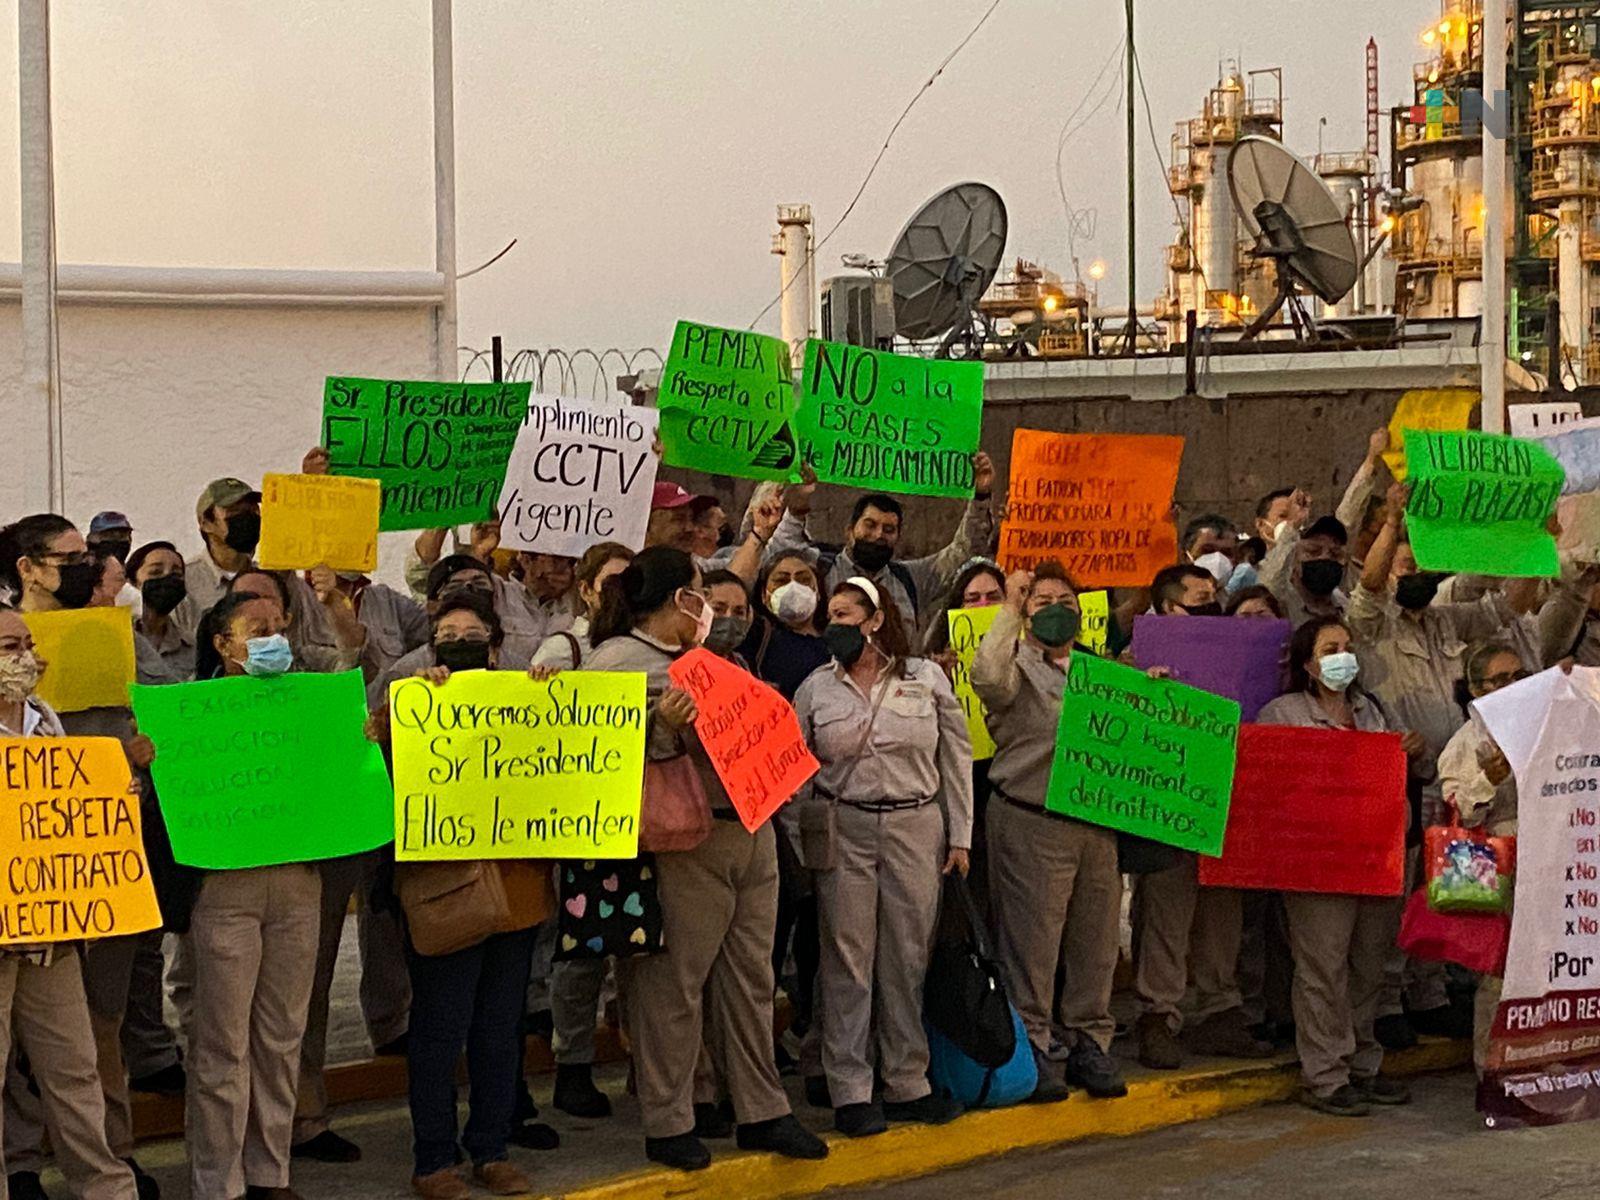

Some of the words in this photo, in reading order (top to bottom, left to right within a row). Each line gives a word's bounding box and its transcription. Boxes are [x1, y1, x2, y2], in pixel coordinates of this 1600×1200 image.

[684, 326, 765, 373] PEMEX
[670, 370, 751, 410] Respeta
[764, 384, 784, 413] el
[811, 343, 879, 407] NO
[891, 379, 906, 396] a
[924, 371, 953, 402] la
[383, 380, 523, 420] Presidente
[325, 415, 453, 472] ELLOS
[687, 413, 770, 453] CCTV
[818, 402, 946, 447] ESCASES
[533, 442, 649, 495] CCTV
[831, 440, 977, 489] MEDICAMENTOS
[380, 476, 500, 517] mienten
[394, 680, 541, 734] Queremos
[429, 735, 469, 786] Sr
[481, 735, 622, 780] Presidente
[1088, 709, 1129, 742] NO
[1143, 727, 1186, 768] hay
[0, 745, 90, 790] EMEX
[20, 797, 135, 841] RESPETA
[402, 793, 477, 852] Ellos
[491, 794, 516, 847] le
[525, 799, 636, 847] mienten
[8, 849, 144, 895] CONTRATO
[1576, 861, 1597, 881] No
[1577, 888, 1598, 908] No
[1578, 916, 1598, 935] No
